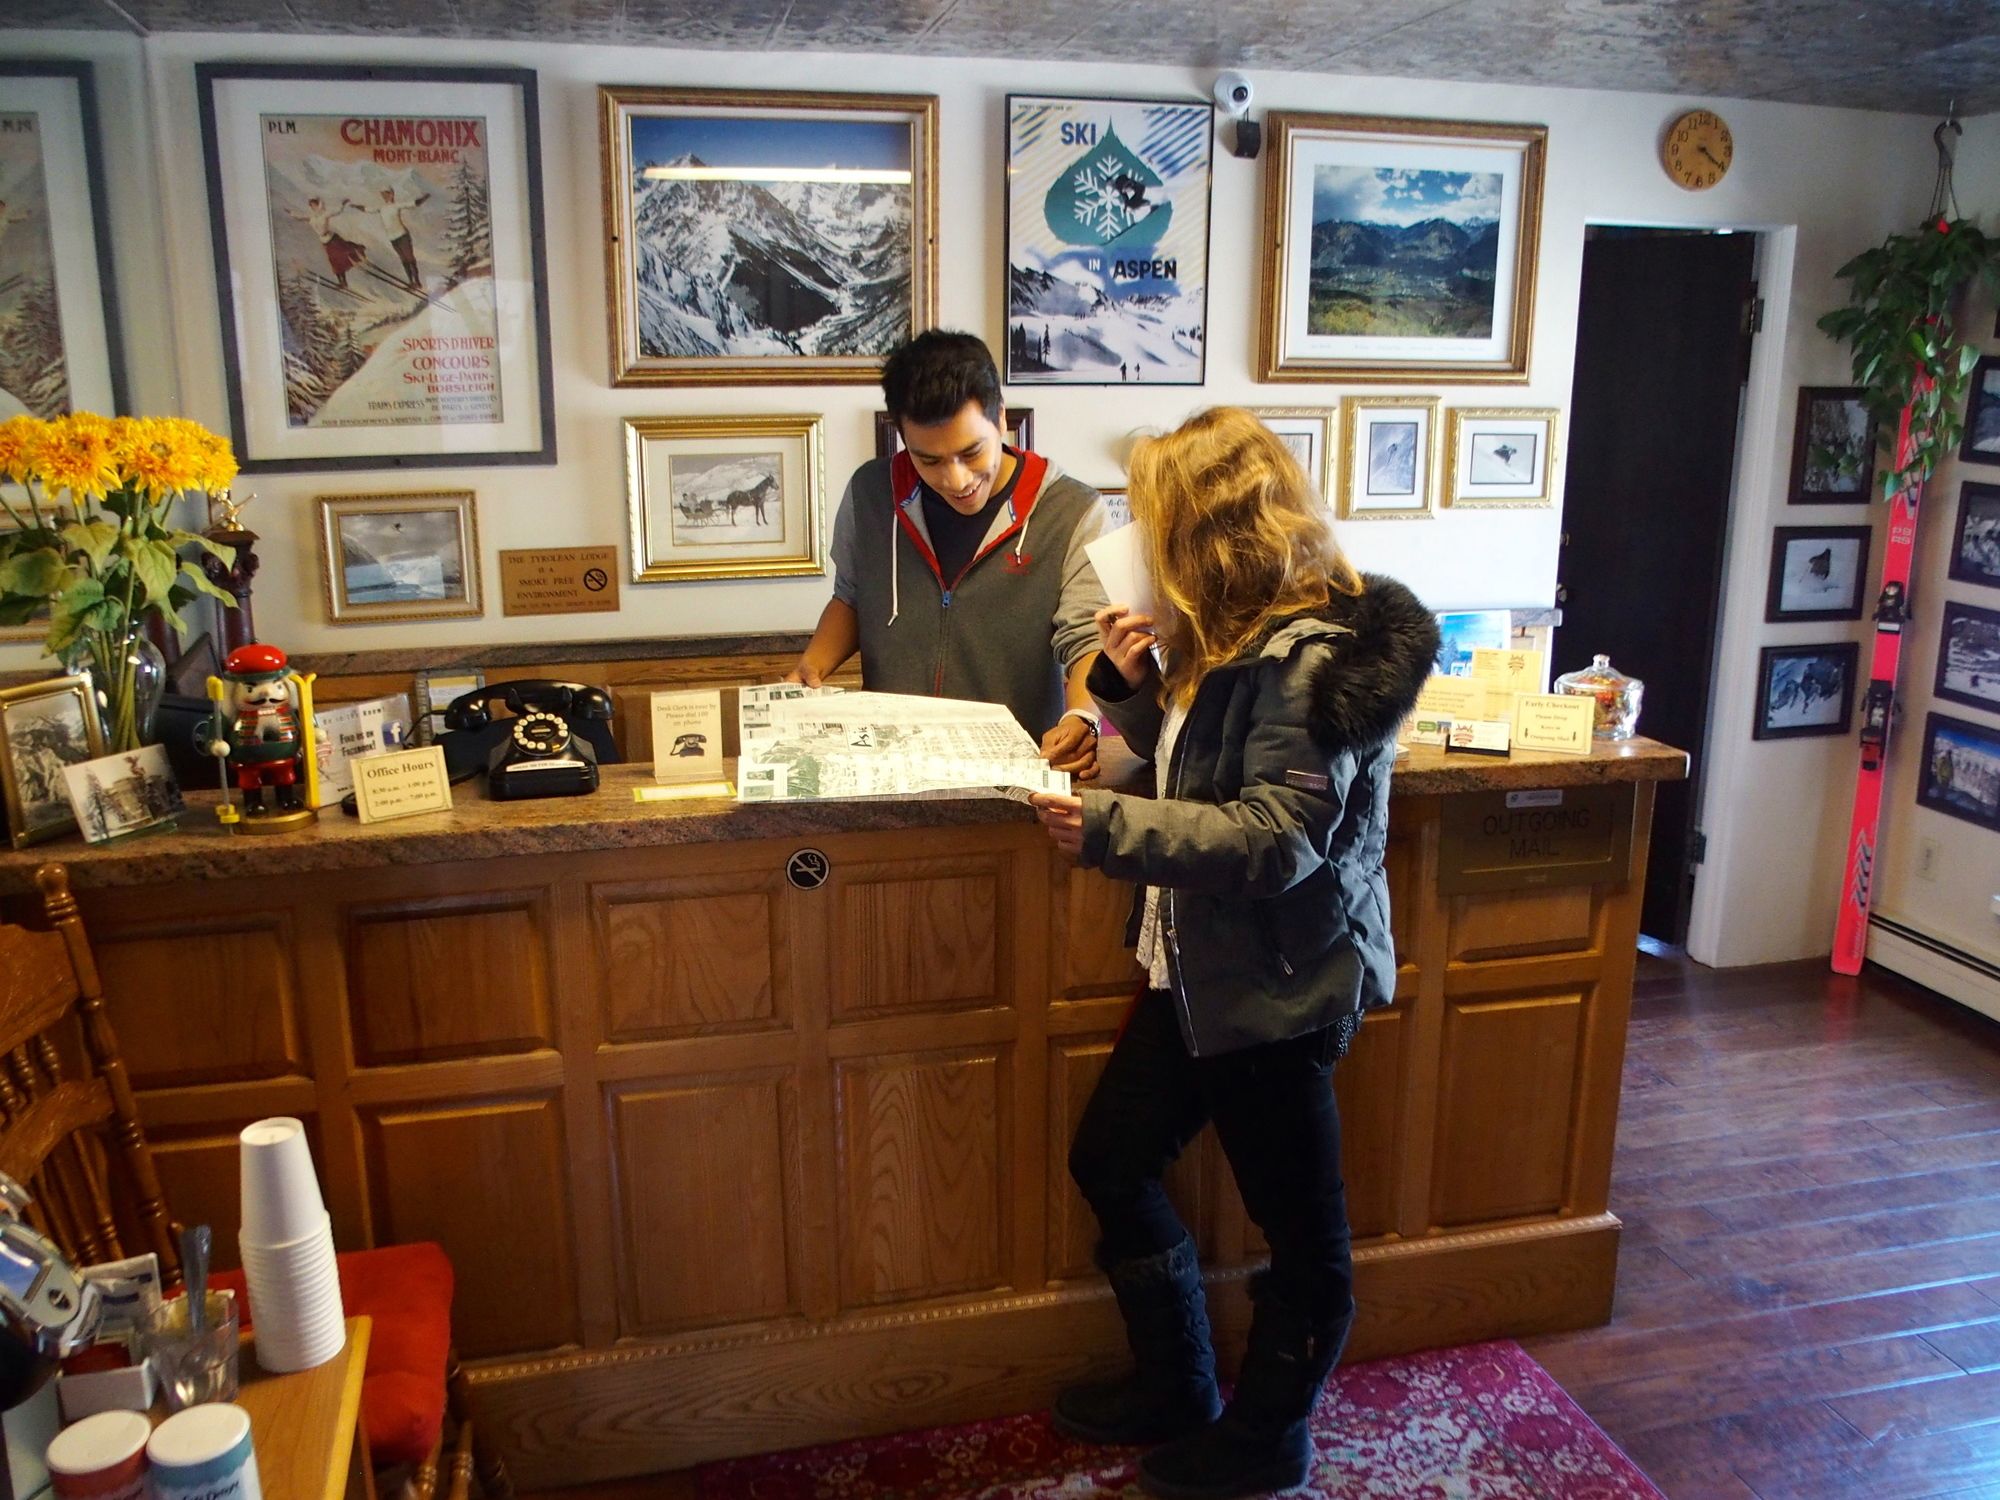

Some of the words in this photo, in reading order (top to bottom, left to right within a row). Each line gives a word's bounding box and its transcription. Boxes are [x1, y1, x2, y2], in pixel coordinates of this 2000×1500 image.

[340, 118, 481, 148] CHAMONIX
[1060, 121, 1097, 146] SKI
[1677, 130, 1689, 142] 10
[373, 149, 459, 164] MONT-BLANC
[1671, 143, 1679, 155] 9
[1674, 160, 1682, 172] 8
[1684, 171, 1693, 184] 7
[1696, 176, 1703, 187] 6
[1088, 259, 1100, 272] IN
[1112, 259, 1177, 279] ASPEN
[402, 337, 449, 353] SPORTS
[412, 355, 490, 370] CONCOURS
[427, 383, 495, 394] BOBSLEIGH
[531, 553, 575, 563] TYROLEAN
[517, 590, 578, 599] ENVIRONMENT
[367, 766, 400, 778] Office
[402, 761, 435, 773] Hours
[1482, 808, 1591, 836] OUTGOING
[1509, 837, 1561, 859] MAIL
